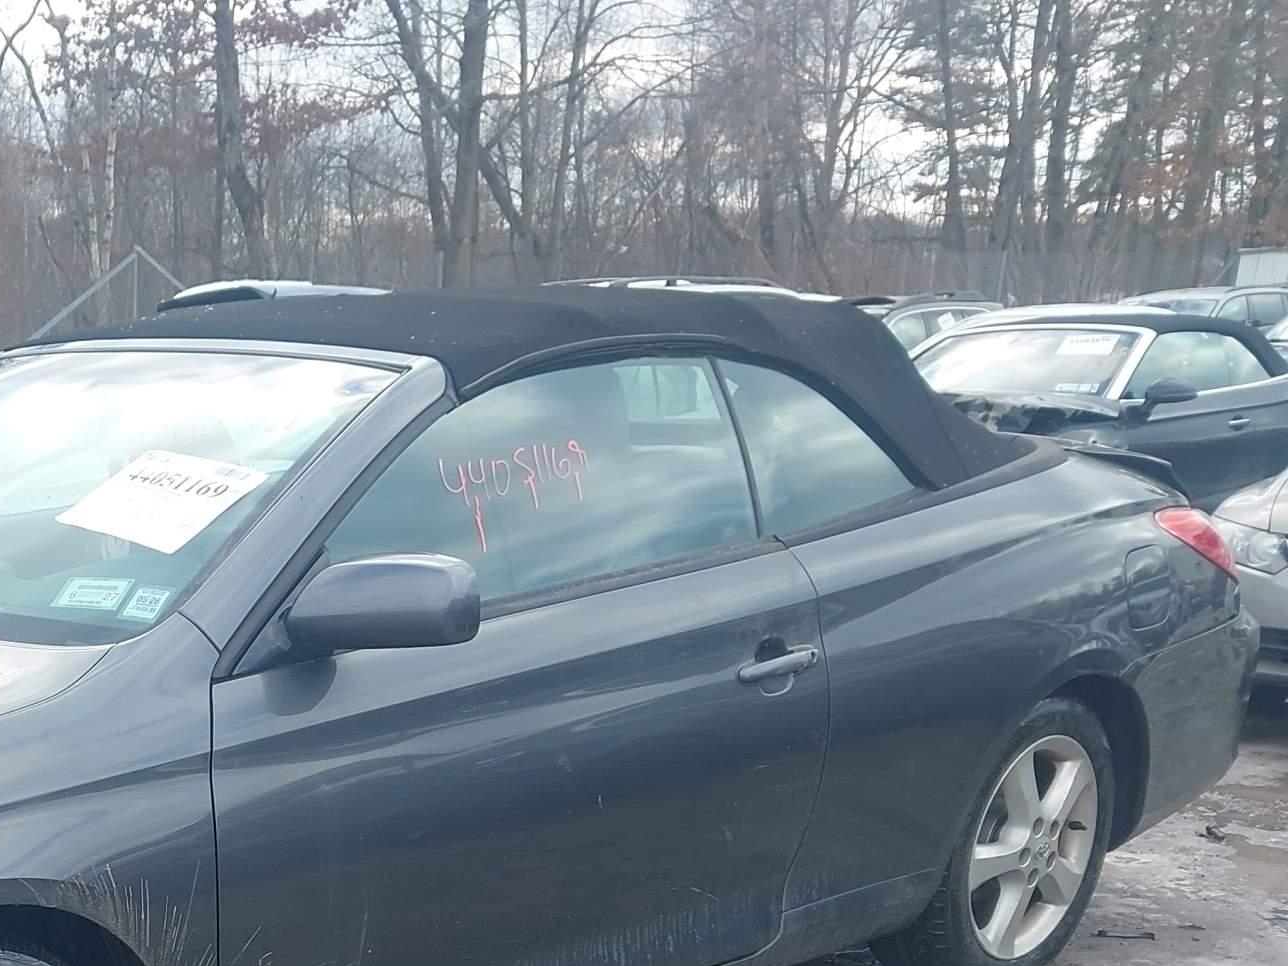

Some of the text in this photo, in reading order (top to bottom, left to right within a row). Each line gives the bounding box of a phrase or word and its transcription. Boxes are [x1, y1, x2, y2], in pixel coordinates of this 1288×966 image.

[127, 467, 231, 499] 44051169
[438, 439, 589, 514] 44051169
[102, 592, 120, 601] 27
